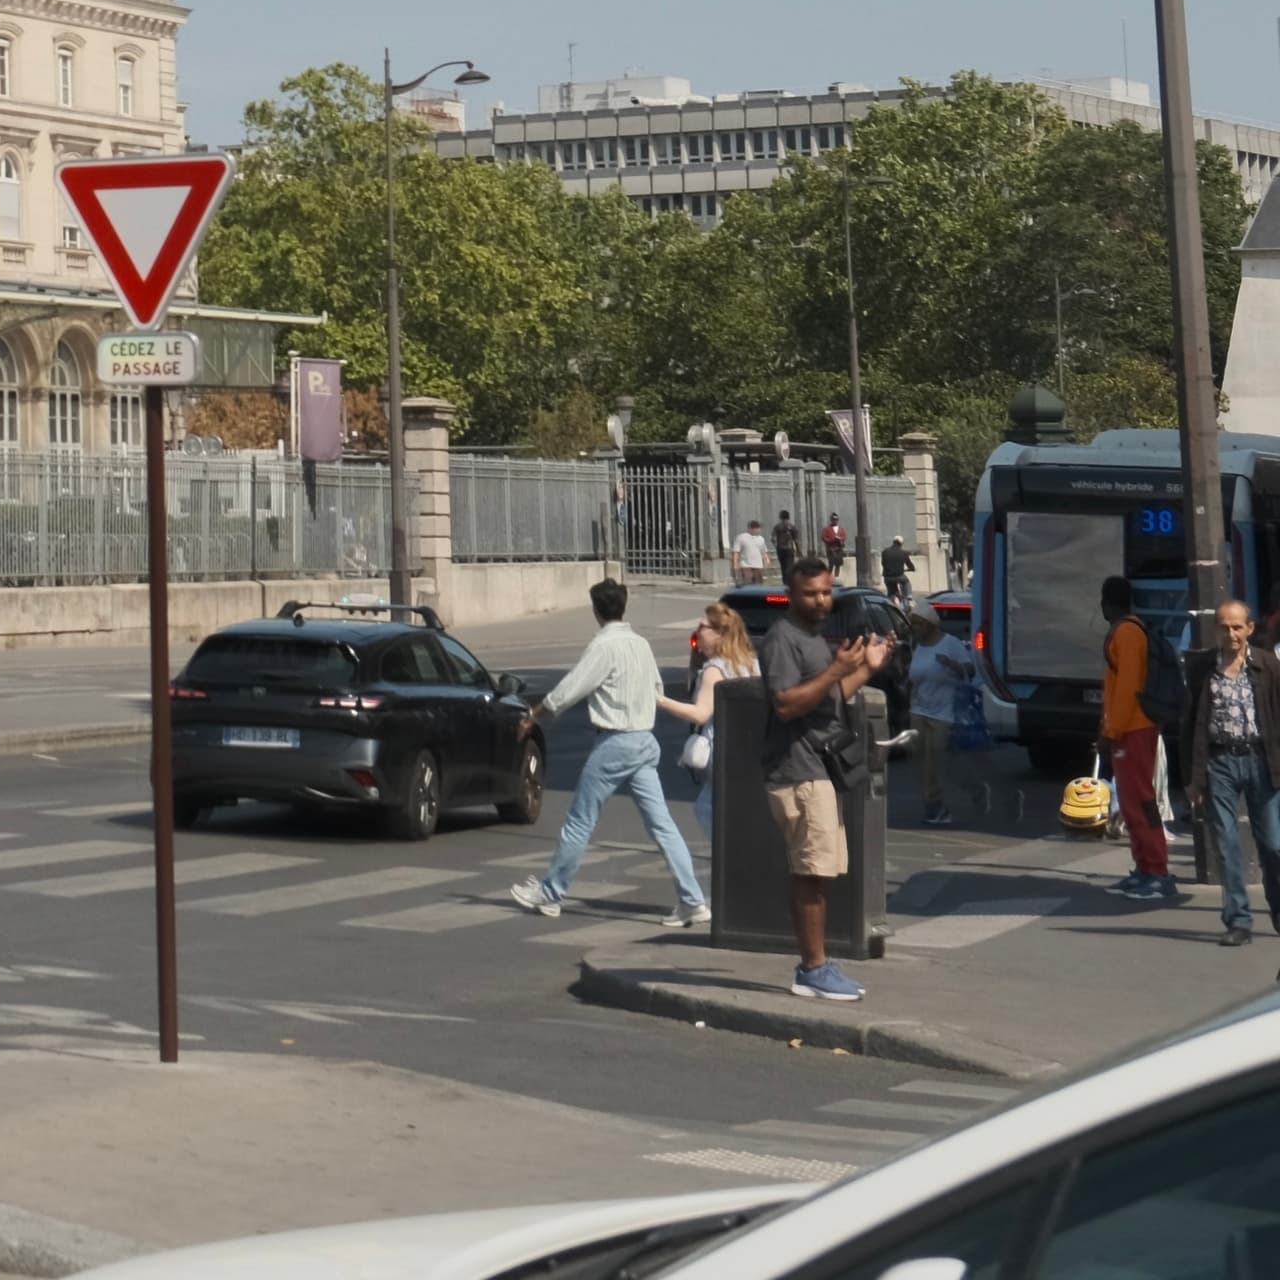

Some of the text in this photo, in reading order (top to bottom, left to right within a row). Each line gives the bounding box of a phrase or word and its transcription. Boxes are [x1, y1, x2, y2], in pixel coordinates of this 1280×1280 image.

[110, 340, 182, 356] CÉDEZ LE
[112, 361, 181, 376] PASSAGE
[1070, 480, 1113, 490] véhicule
[1114, 481, 1155, 492] hybride
[1142, 509, 1173, 533] 38
